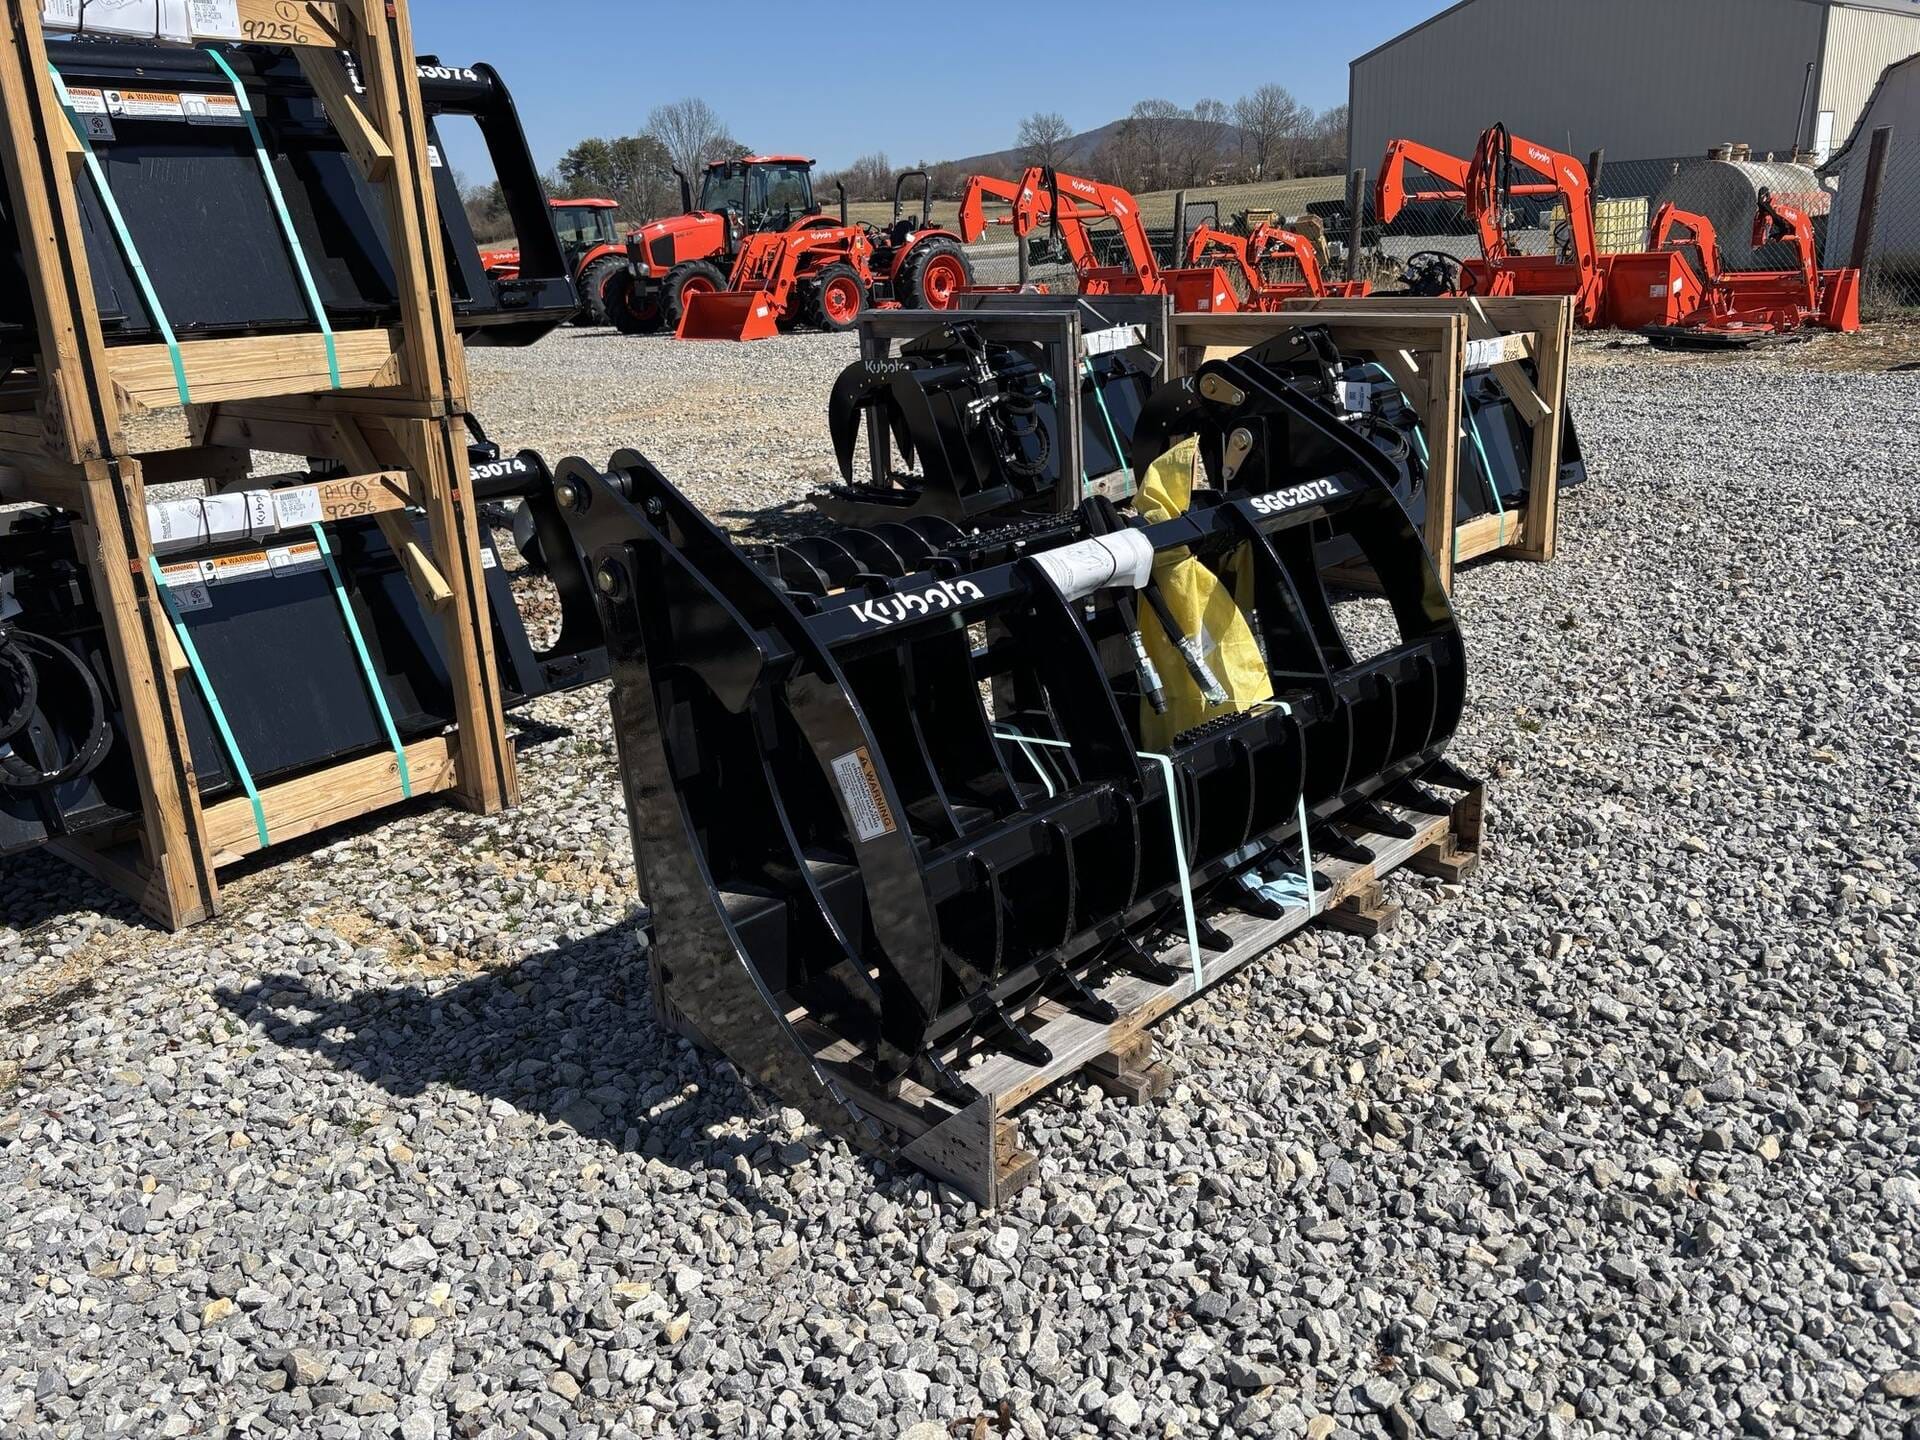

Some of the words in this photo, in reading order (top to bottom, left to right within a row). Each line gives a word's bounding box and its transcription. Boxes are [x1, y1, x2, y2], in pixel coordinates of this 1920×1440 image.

[243, 20, 308, 43] 92256
[66, 88, 96, 97] ARNING
[137, 93, 174, 102] WARNING
[1528, 147, 1550, 164] Kubota
[1071, 178, 1096, 194] Kubota
[810, 232, 832, 240] Kubota
[1250, 480, 1338, 514] SGC2072
[326, 501, 377, 520] 92256
[228, 554, 262, 564] WARNING
[164, 563, 194, 574] WARNING
[848, 580, 985, 624] Kubota
[865, 770, 892, 826] WARNING
